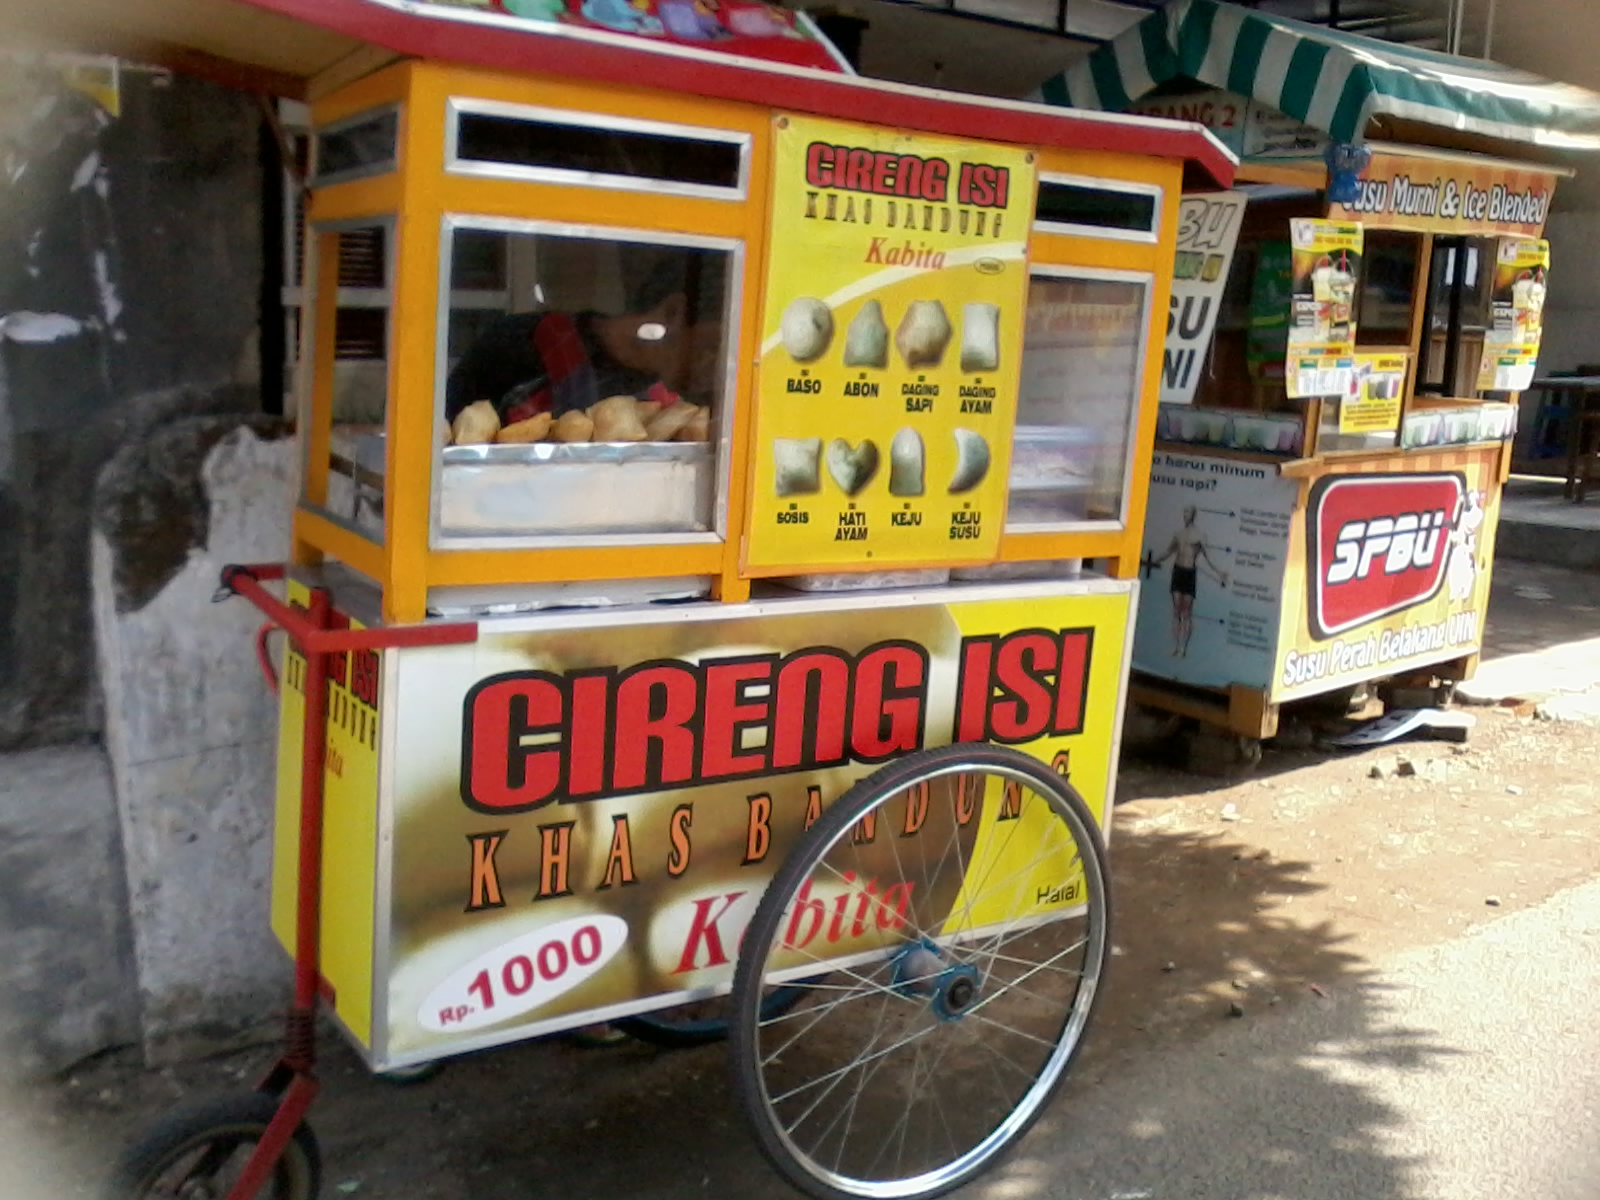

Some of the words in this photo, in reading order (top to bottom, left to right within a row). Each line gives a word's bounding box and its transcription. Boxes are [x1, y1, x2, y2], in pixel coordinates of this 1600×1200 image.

[1221, 105, 1236, 127] 2
[806, 141, 949, 202] CIRENG
[958, 161, 1010, 209] ISI
[1342, 179, 1387, 213] usu
[1388, 173, 1440, 216] Murni
[1440, 179, 1460, 218] &
[1462, 180, 1489, 220] Ice
[1487, 183, 1548, 224] Blended
[804, 191, 873, 224] KHAS
[864, 237, 946, 270] Kabita
[787, 378, 822, 394] BASO
[843, 381, 880, 398] ABON
[901, 383, 940, 397] DAGING
[958, 386, 996, 399] DAGING
[905, 397, 933, 413] SAPI
[959, 399, 992, 414] AYAM
[1210, 463, 1266, 479] minum
[776, 511, 809, 524] SOSIS
[838, 512, 866, 526] HATI
[891, 512, 922, 526] KEJU
[951, 511, 981, 525] KEJU
[834, 527, 868, 541] AYAM
[949, 526, 980, 540] SUSU
[1326, 510, 1446, 585] SPBU
[1283, 650, 1329, 686] Susu
[1329, 630, 1377, 675] Perah
[1377, 616, 1447, 663] Belakang
[1446, 609, 1477, 648] UIN
[460, 639, 931, 815] CIRENG
[952, 626, 1095, 745] ISI
[464, 803, 694, 912] KHAS
[1036, 880, 1080, 905] Halal
[671, 870, 916, 975] Kbita
[438, 1004, 475, 1027] Rp.
[467, 925, 602, 1010] 1000
